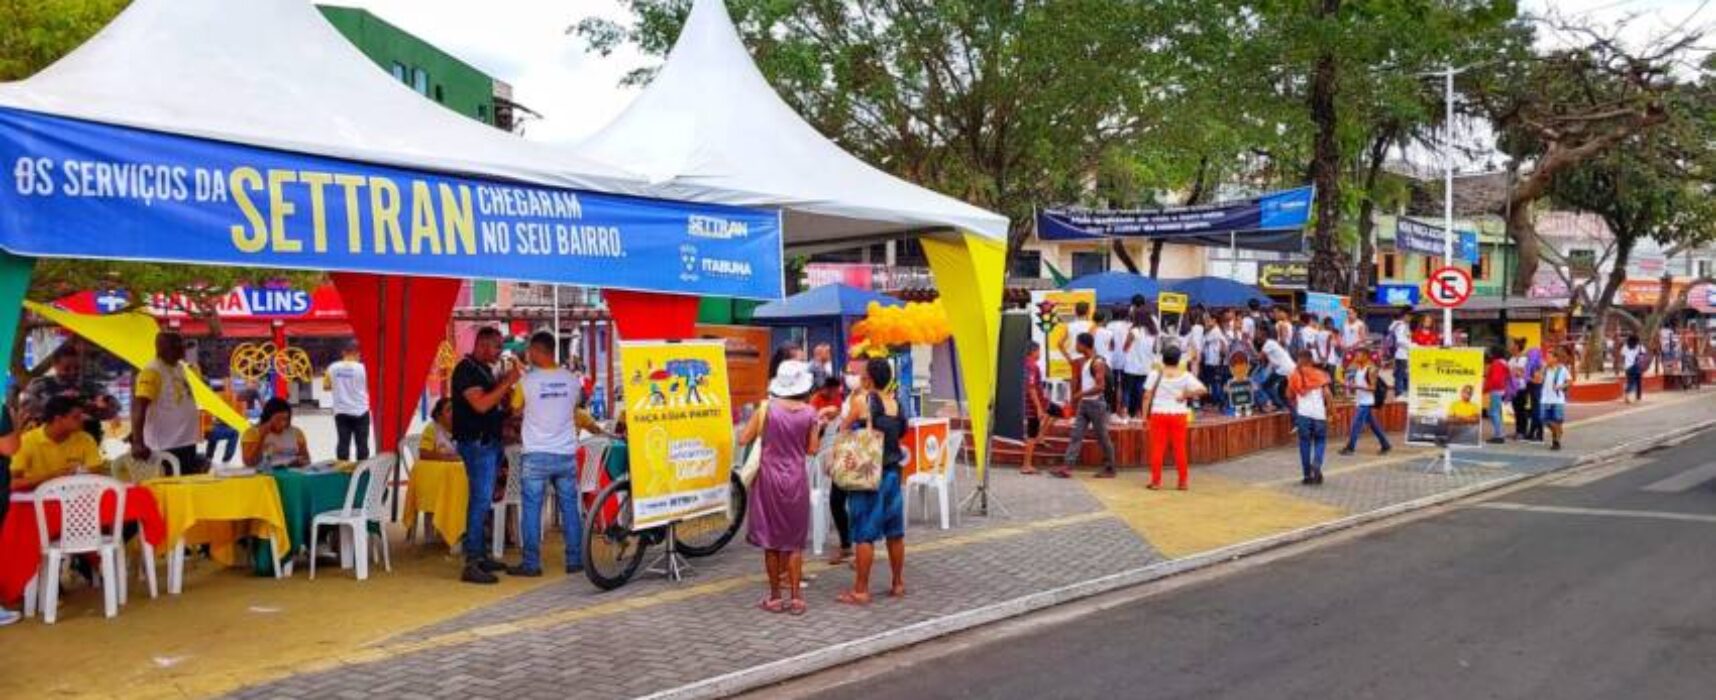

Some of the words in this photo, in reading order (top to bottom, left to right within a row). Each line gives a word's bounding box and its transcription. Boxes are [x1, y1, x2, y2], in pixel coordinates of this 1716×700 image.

[15, 156, 54, 196] OS
[62, 160, 188, 206] SERVIÇOS
[195, 168, 228, 203] DA
[228, 165, 478, 255] SETTRAN
[476, 185, 582, 220] CHEGARAM
[481, 220, 510, 255] NO
[516, 222, 551, 256] SEU
[556, 225, 627, 258] BAIRRO.
[688, 214, 748, 239] SETTRAN
[702, 257, 752, 276] ITABUNA
[1440, 276, 1458, 299] E
[251, 289, 308, 313] LINS
